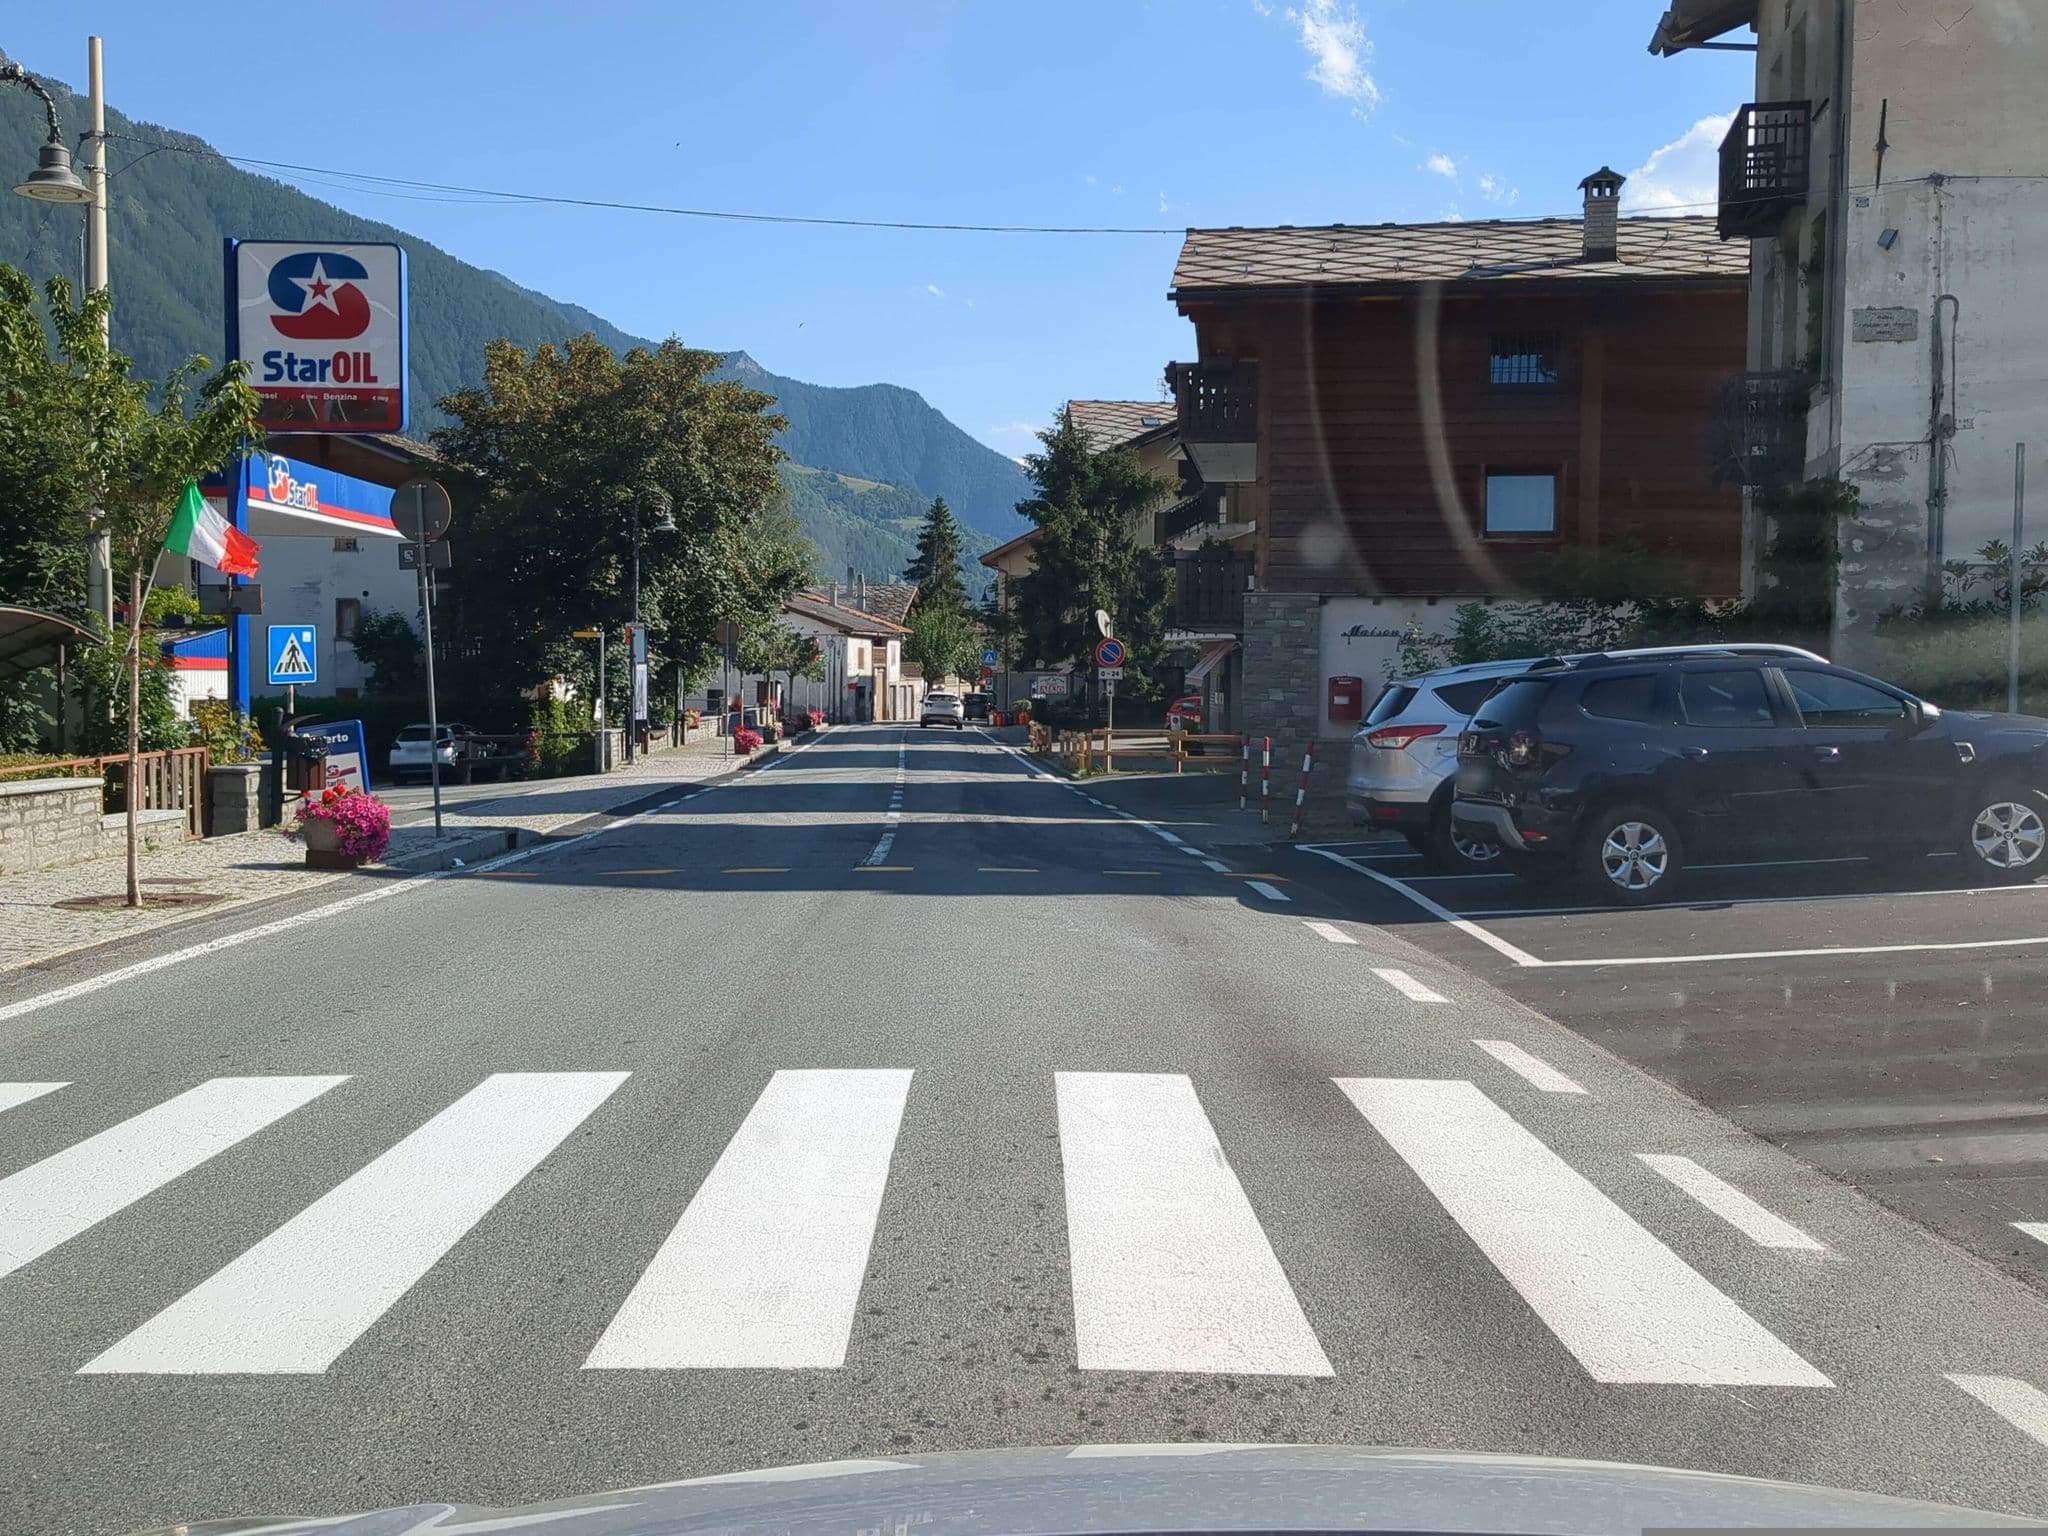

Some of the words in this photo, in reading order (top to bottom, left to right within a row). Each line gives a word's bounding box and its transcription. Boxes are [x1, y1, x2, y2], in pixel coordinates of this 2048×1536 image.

[262, 350, 378, 384] StarOIL
[323, 392, 358, 401] Benzina
[288, 478, 319, 511] StarOIL
